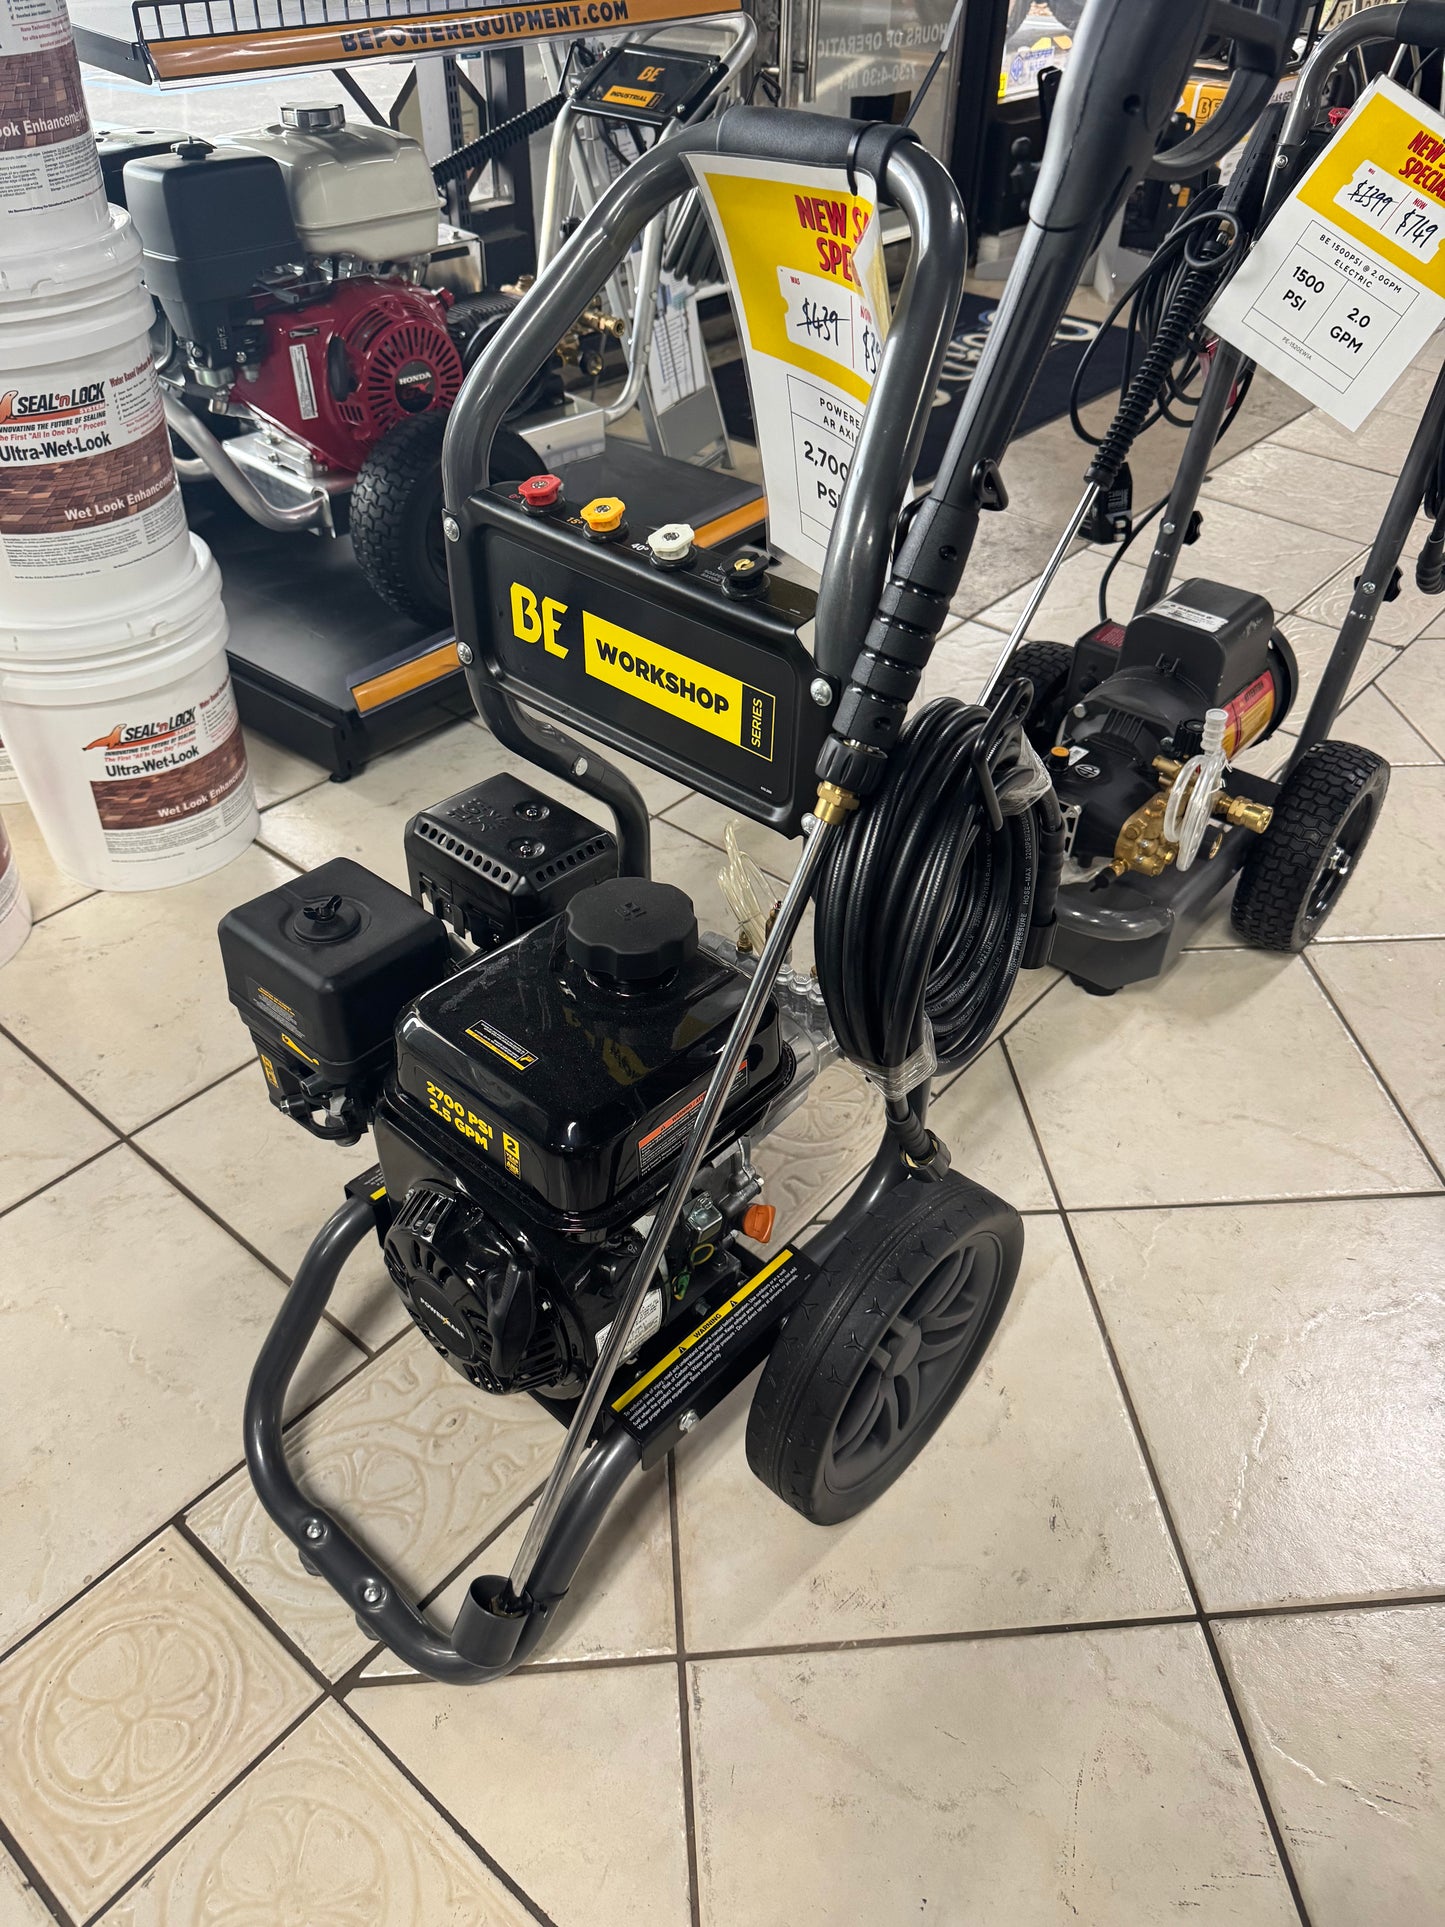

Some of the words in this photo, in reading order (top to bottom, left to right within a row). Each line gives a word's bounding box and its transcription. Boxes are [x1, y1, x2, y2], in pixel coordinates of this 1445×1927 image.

[341, 0, 629, 52] BEPOWEREQUIPMENT.COM
[1407, 130, 1444, 163] NEW
[794, 194, 847, 238] NEW
[1412, 197, 1428, 210] NOW
[1395, 208, 1439, 248] $749
[1319, 233, 1329, 245] BE
[1331, 242, 1362, 267] 1500PSI
[1370, 269, 1402, 294] 2.0GPM
[1334, 258, 1373, 288] ELECTRIC
[1292, 266, 1325, 294] 1500
[1282, 289, 1307, 311] PSI
[1347, 308, 1371, 328] 2.0
[1329, 325, 1364, 354] GPM
[398, 371, 432, 385] HONDA
[17, 393, 58, 415] SEAL
[71, 381, 105, 406] LOCK
[79, 402, 106, 414] SYSTEM
[10, 432, 27, 441] First
[43, 429, 50, 438] In
[51, 427, 65, 437] One
[83, 420, 107, 431] Process
[37, 422, 49, 431] THE
[50, 419, 73, 429] FUTURE
[74, 417, 82, 425] OF
[83, 410, 106, 424] SEALING
[823, 415, 836, 430] AR
[0, 430, 112, 462] Ultra-Wet-Look
[64, 507, 93, 521] Wet
[95, 498, 125, 515] Look
[510, 581, 569, 660] BE
[596, 637, 730, 716] WORKSHOP
[124, 723, 159, 742] SEAL
[169, 706, 196, 730] LOCK
[751, 697, 763, 748] SERIES
[105, 744, 200, 777] Ultra-Wet-Look
[158, 806, 181, 818] Wet
[183, 795, 209, 810] Look
[1014, 912, 1028, 950] PRESSURE
[1023, 866, 1032, 905] HOSE-MAX
[426, 1080, 465, 1117] 2700
[467, 1110, 494, 1139] PSI
[428, 1097, 452, 1122] 2.5
[454, 1117, 489, 1151] GPM
[506, 1138, 517, 1150] 2
[693, 1312, 721, 1338] WARNING
